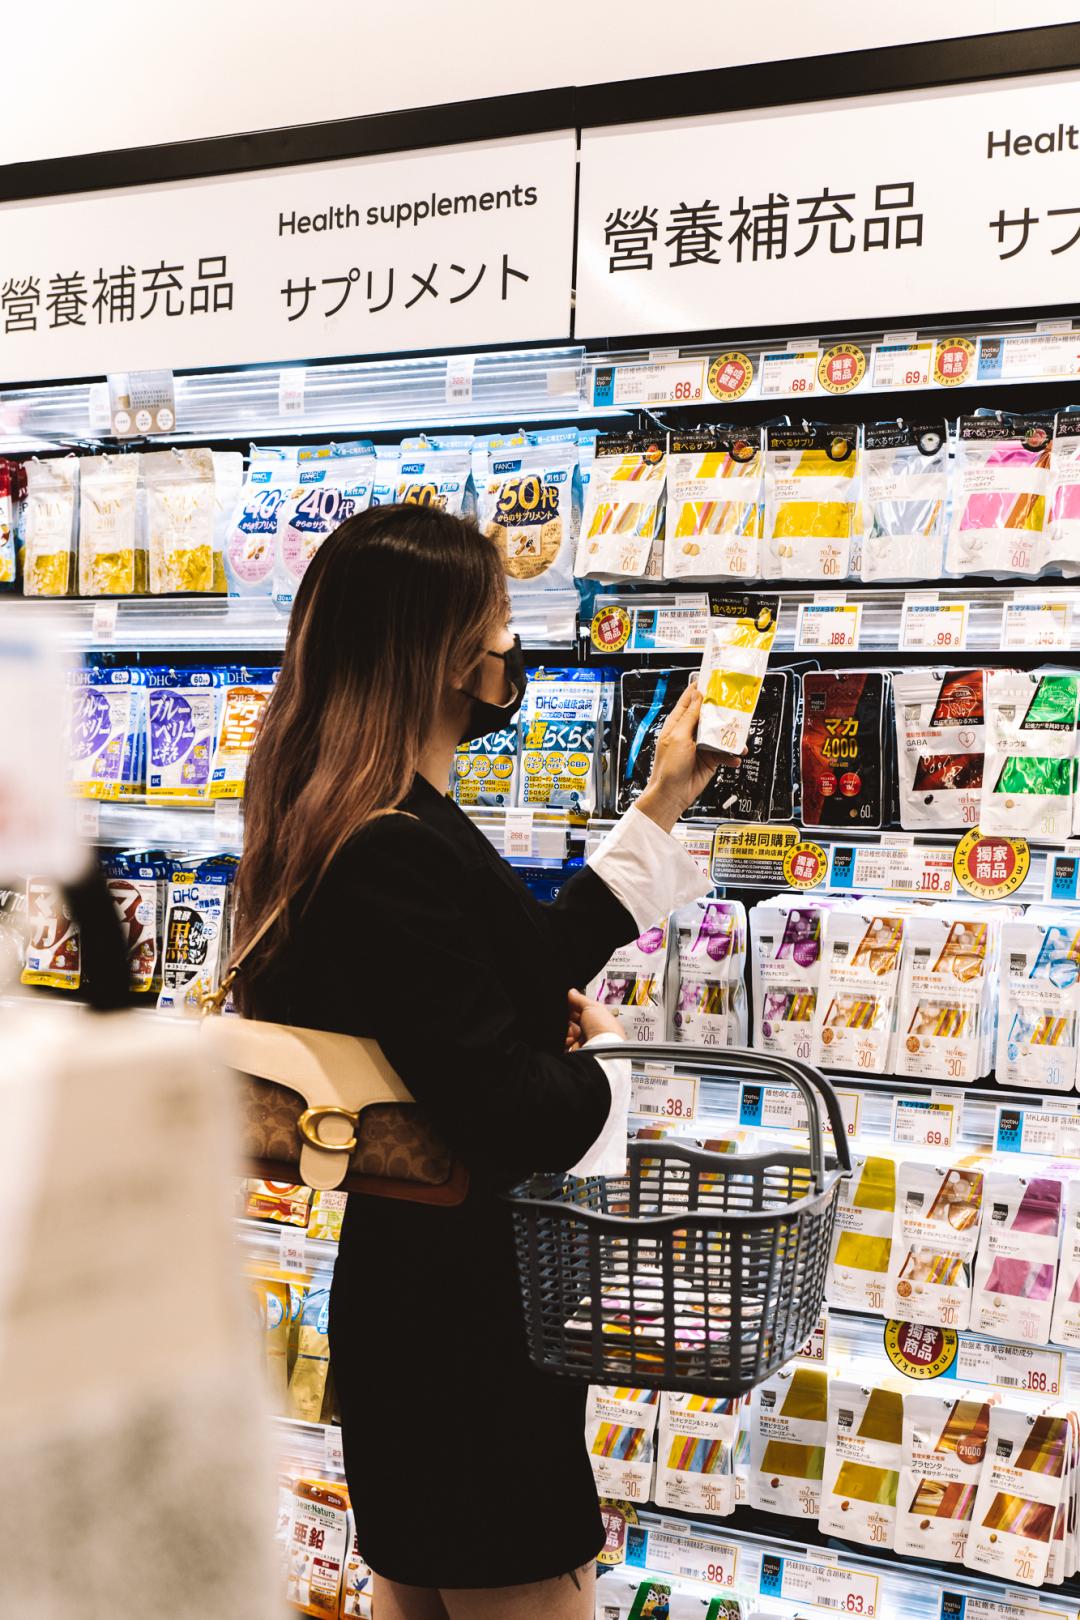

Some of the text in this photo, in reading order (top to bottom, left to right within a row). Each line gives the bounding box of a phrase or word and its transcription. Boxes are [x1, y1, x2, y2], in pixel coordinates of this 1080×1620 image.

[278, 184, 538, 237] Health supplements
[603, 181, 924, 273] 營養補充品
[1, 256, 234, 334] 營養補充品
[280, 253, 530, 321] サプリメント
[832, 358, 852, 370] 獨家
[943, 352, 968, 363] 獨家
[832, 369, 852, 380] 商品
[943, 362, 967, 373] 商品
[669, 381, 701, 400] $68.8
[962, 428, 1009, 438] 食べるサプリ
[770, 438, 814, 448] 食べるサプリ
[866, 436, 907, 448] 食べるサプリ
[494, 462, 516, 471] FANCL
[499, 475, 560, 511] 50代
[298, 487, 355, 519] 40代
[497, 511, 553, 522] からのサプリメント
[712, 604, 748, 615] 食べるサプリ
[150, 675, 172, 686] DHC
[226, 672, 251, 683] DHC
[150, 695, 191, 721] ブルー
[155, 720, 195, 748] ベリー
[824, 717, 859, 736] マカ
[822, 738, 858, 758] 4000
[906, 739, 928, 747] GABA
[738, 799, 752, 813] 120
[860, 804, 871, 818] 60
[797, 855, 816, 868] 獨家
[976, 845, 1008, 862] 獨家
[174, 874, 186, 882] 20
[794, 866, 812, 878] 商品
[976, 862, 1007, 879] 商品
[1055, 871, 1067, 879] kiyo
[915, 871, 951, 891] $118.8
[173, 888, 199, 904] DHC
[797, 1042, 810, 1058] 60
[857, 1051, 871, 1067] 30
[948, 1059, 962, 1076] 30
[1046, 1067, 1060, 1084] 30
[661, 1098, 692, 1117] $38.8
[1025, 1114, 1050, 1122] MKLAB
[867, 1291, 881, 1309] 30
[940, 1307, 954, 1324] 30
[907, 1323, 939, 1344] 獨家
[1021, 1319, 1036, 1338] 30
[903, 1338, 933, 1362] 商品
[1021, 1371, 1058, 1393] $168.8
[760, 1421, 790, 1431] 天然ビタミンE
[911, 1460, 943, 1470] プラセンタ
[293, 1521, 325, 1551] 亜鉛
[702, 1563, 733, 1585] $98.8
[1016, 1559, 1030, 1578] 20
[840, 1593, 874, 1616] $63.8
